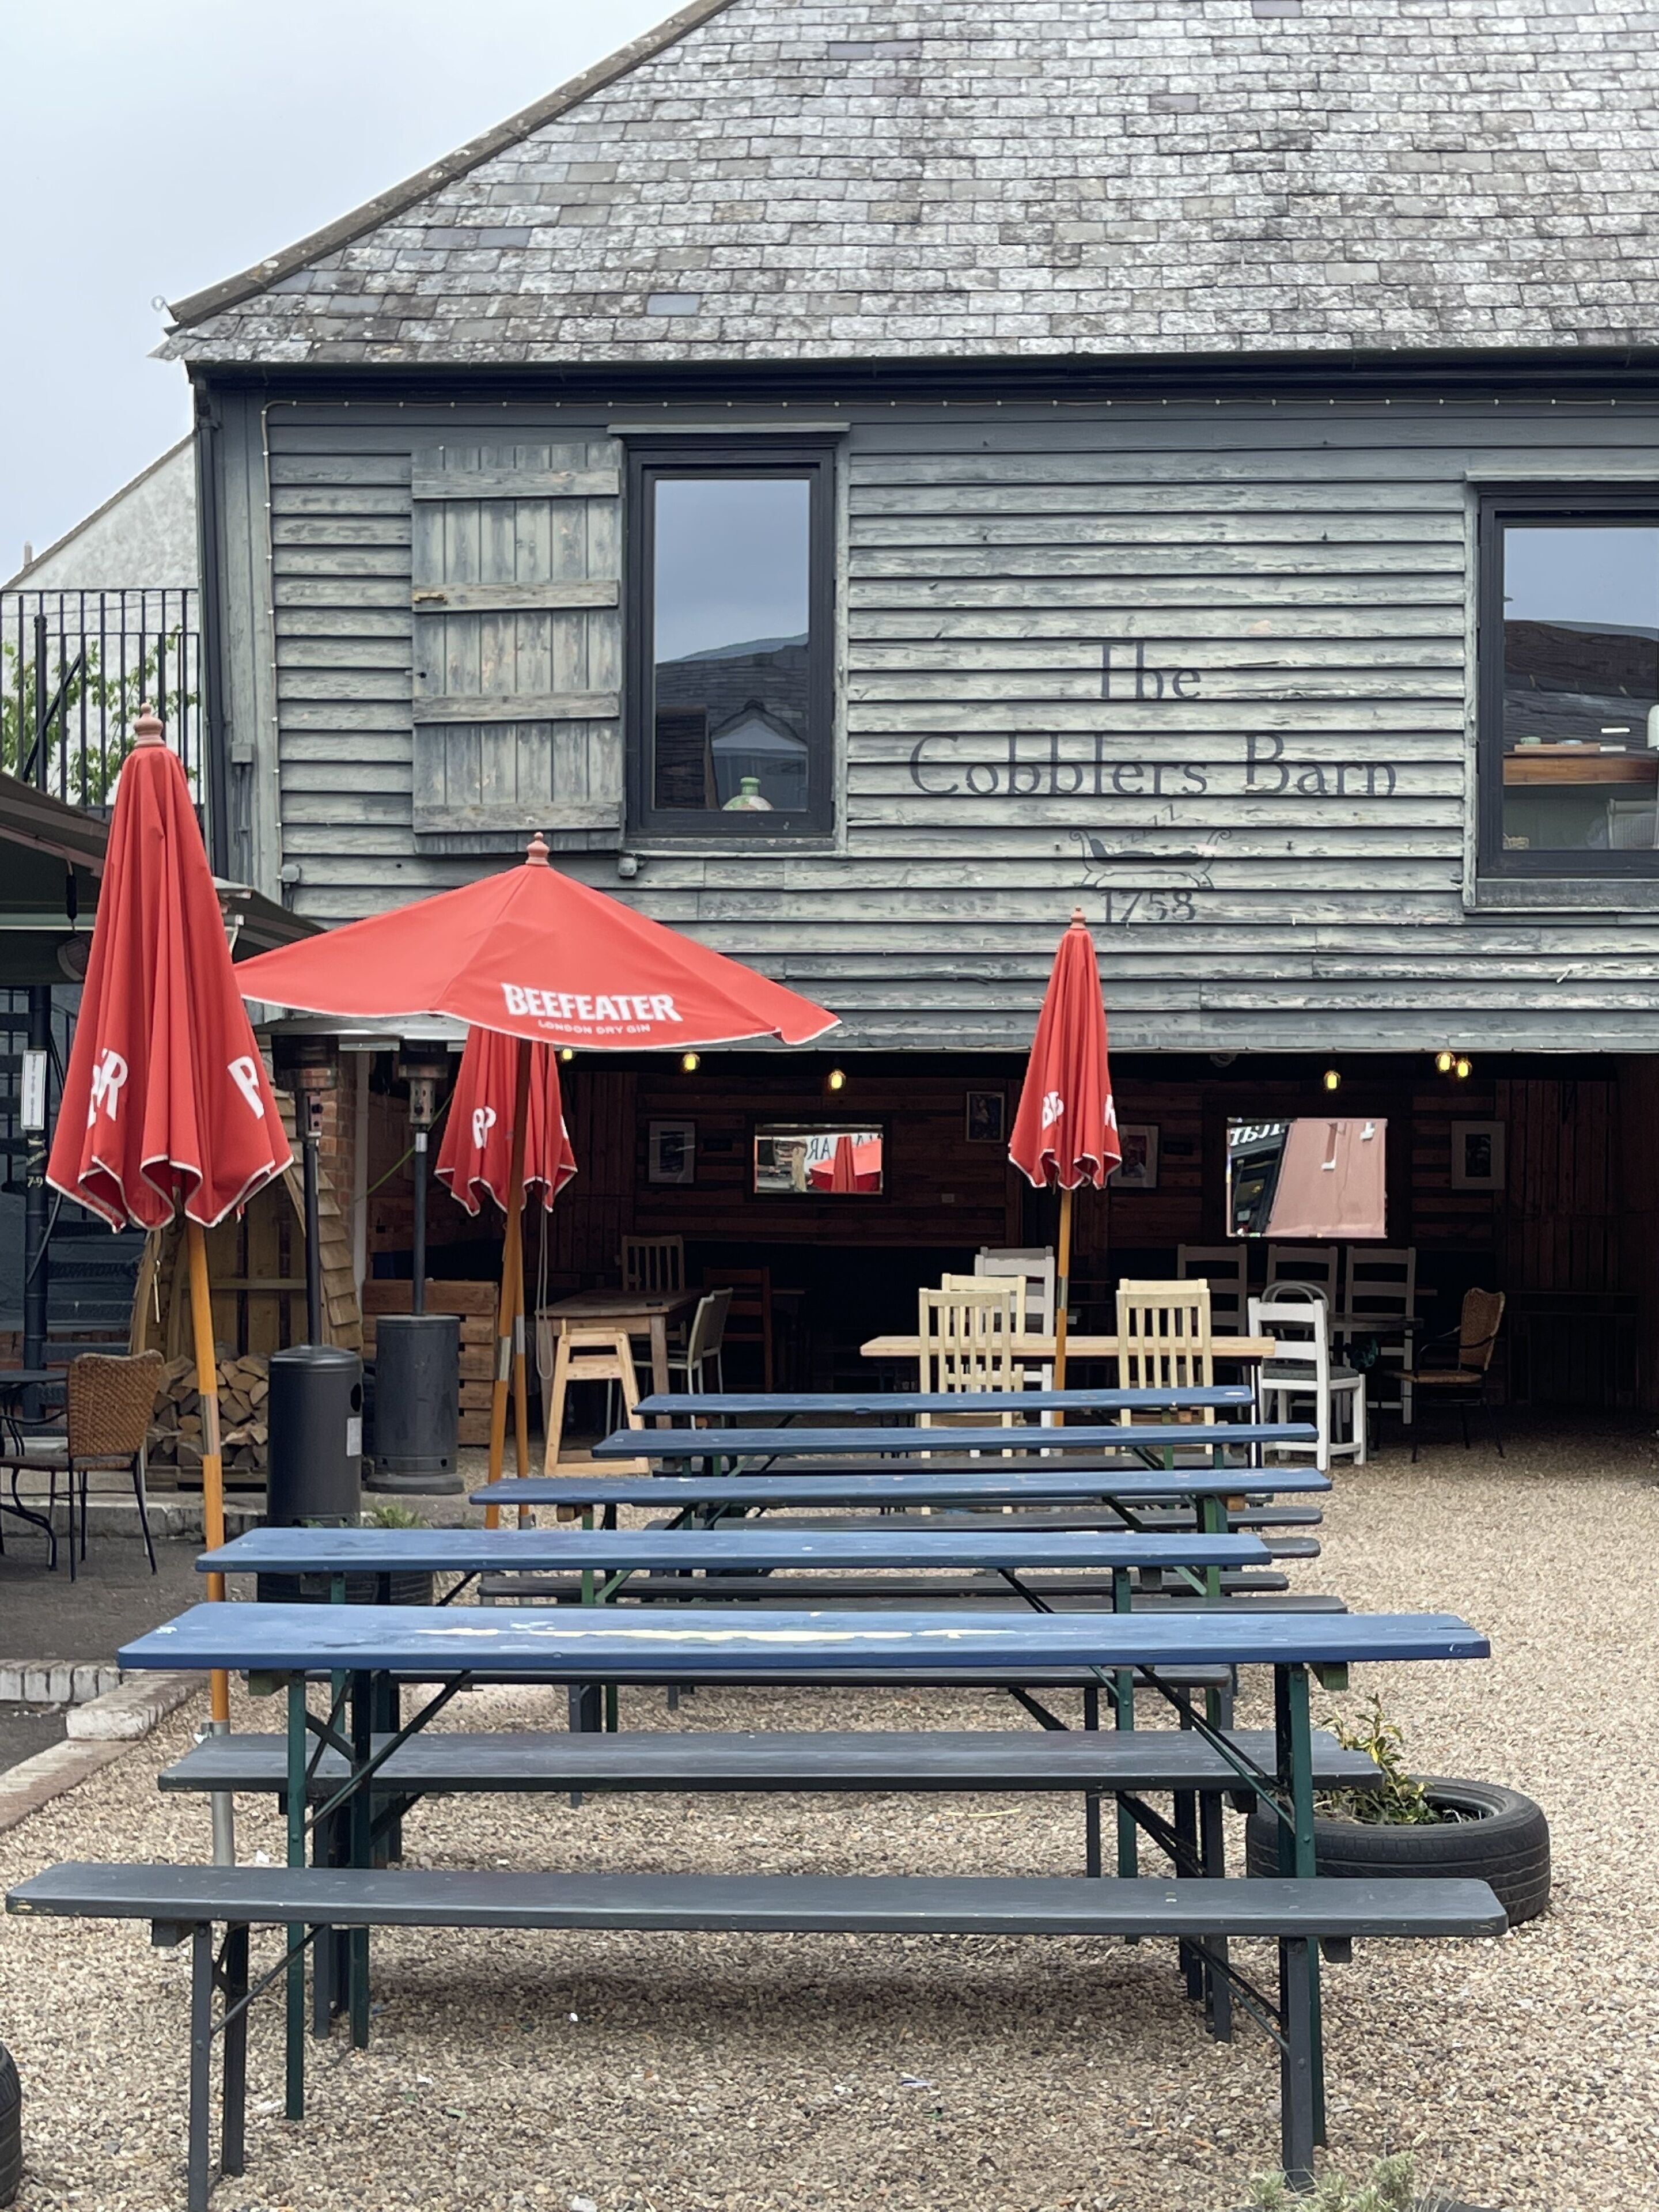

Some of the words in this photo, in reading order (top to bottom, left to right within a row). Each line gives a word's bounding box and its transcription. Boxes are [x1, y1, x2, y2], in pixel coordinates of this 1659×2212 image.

[1079, 639, 1201, 699] The
[909, 733, 1208, 795] Cobblers
[1244, 733, 1396, 796] Barn
[1101, 889, 1196, 922] 1758
[501, 982, 683, 1022] BEEFEATER
[537, 1019, 593, 1035] LONDON
[596, 1025, 623, 1035] DRY
[626, 1023, 651, 1033] GIN
